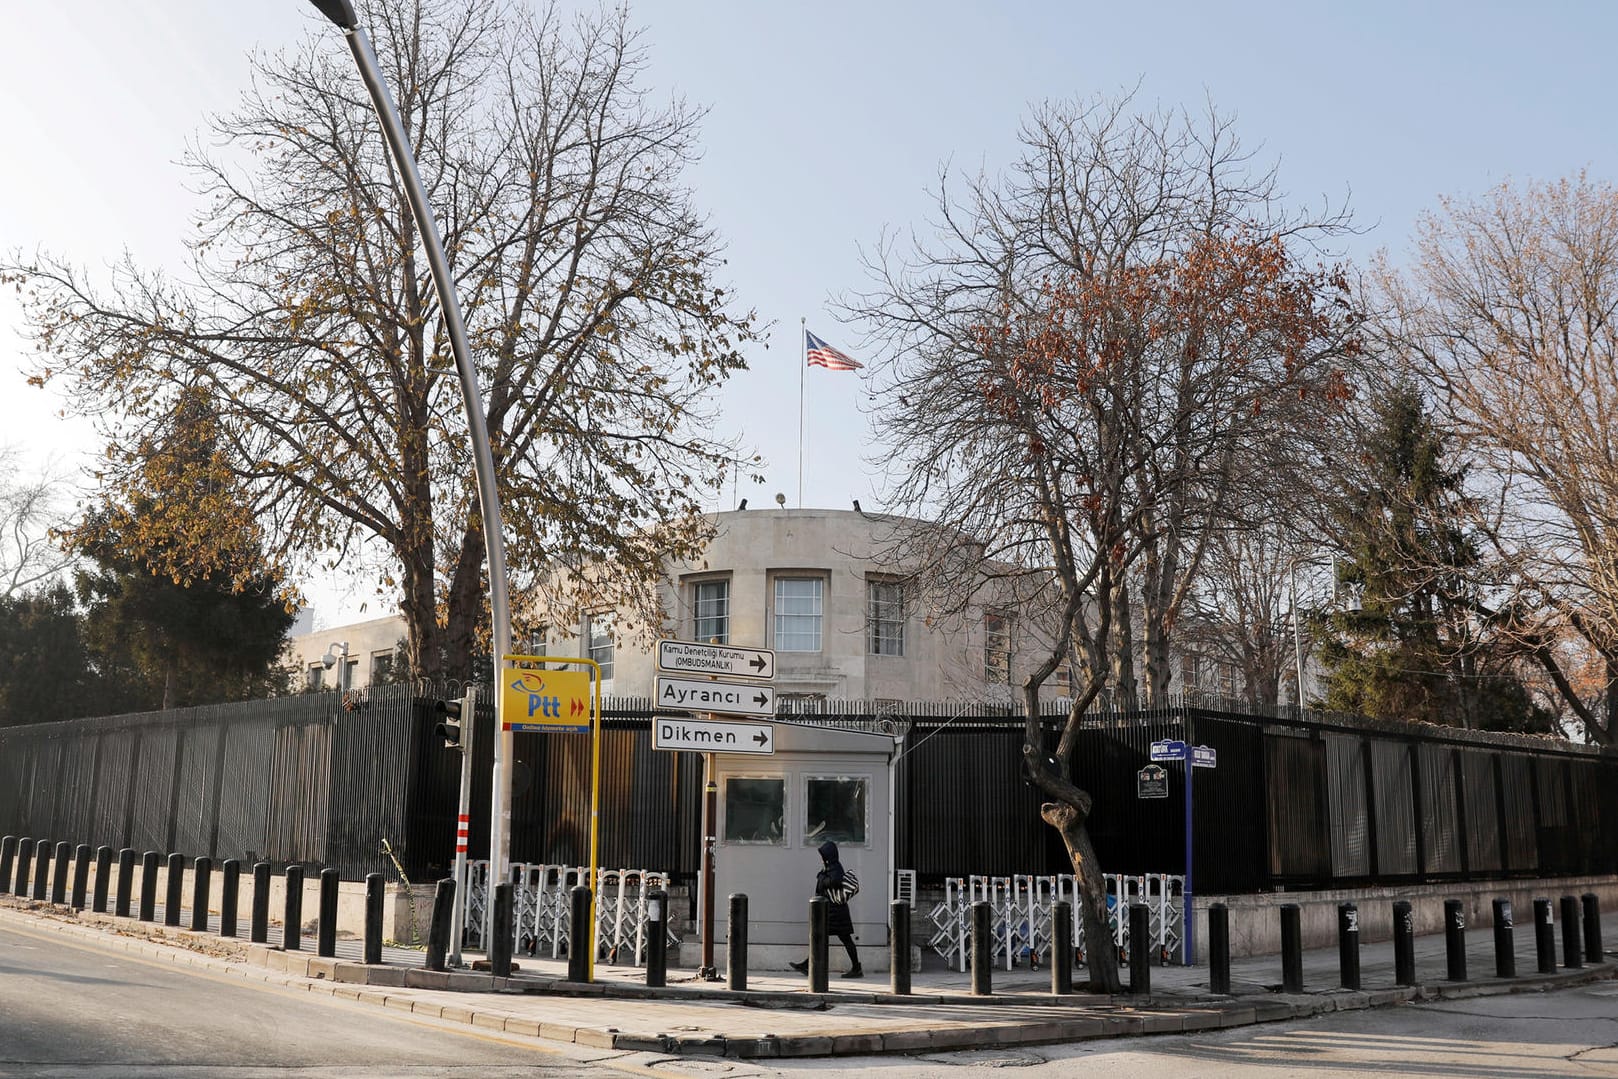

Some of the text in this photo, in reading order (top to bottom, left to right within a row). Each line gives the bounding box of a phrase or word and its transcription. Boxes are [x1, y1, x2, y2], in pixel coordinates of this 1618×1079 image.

[663, 644, 682, 654] Kamu
[718, 649, 745, 660] Kurumu
[675, 657, 733, 672] (OMBUDSMANLIK)
[663, 684, 740, 704] Ayrancı
[528, 693, 560, 718] Ptt
[662, 725, 736, 743] Dikmen
